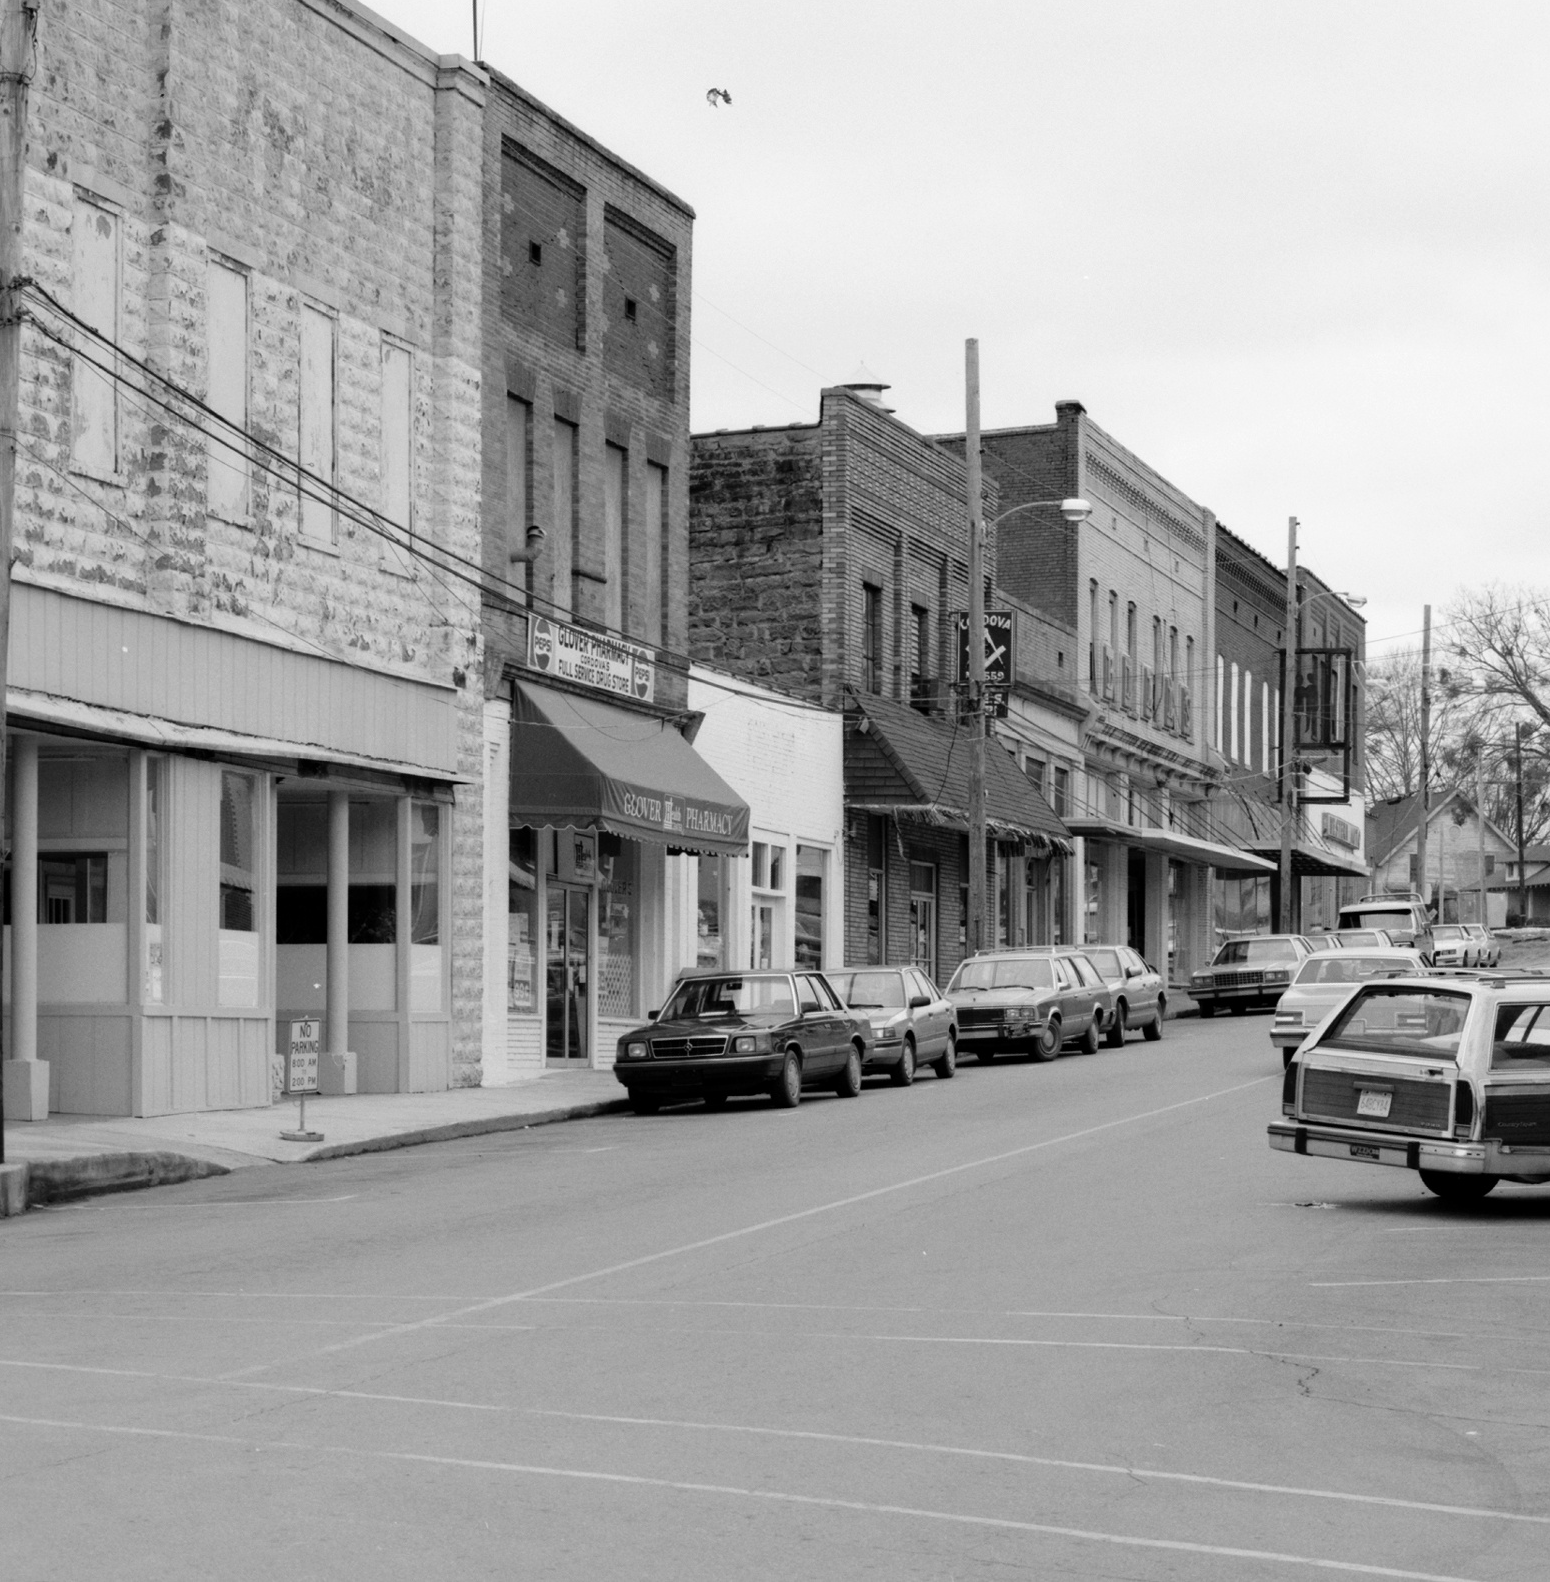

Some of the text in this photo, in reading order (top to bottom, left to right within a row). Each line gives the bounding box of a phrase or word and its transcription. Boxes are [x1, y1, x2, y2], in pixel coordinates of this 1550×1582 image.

[960, 614, 1011, 630] CDOVA
[535, 635, 552, 654] PEPSI
[558, 625, 589, 654] GLOVER
[558, 659, 630, 694] FULL SERVICE DRUG STORE
[624, 793, 662, 822] GLOVER
[686, 807, 733, 835] PHARMACY
[300, 1024, 312, 1038] NO
[291, 1040, 319, 1054] PARKING
[308, 1058, 317, 1067] AM
[308, 1076, 317, 1085] PM
